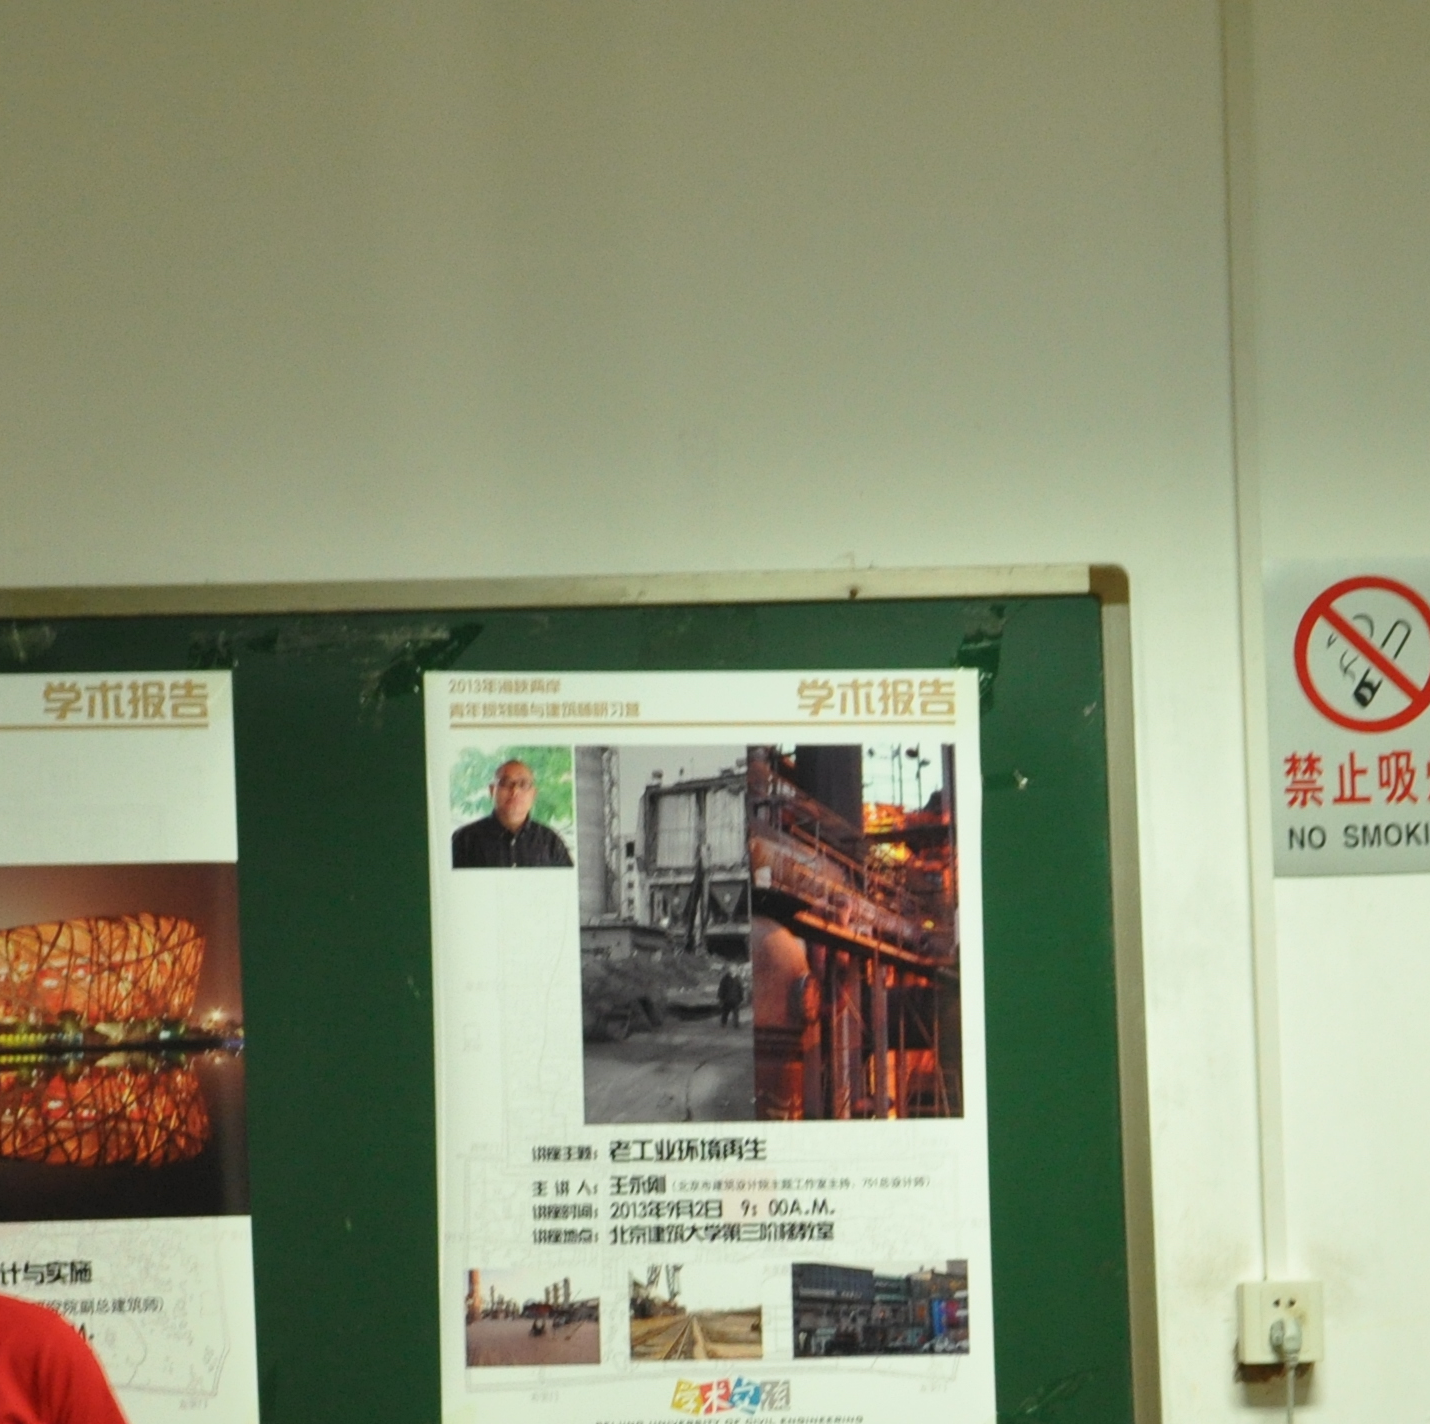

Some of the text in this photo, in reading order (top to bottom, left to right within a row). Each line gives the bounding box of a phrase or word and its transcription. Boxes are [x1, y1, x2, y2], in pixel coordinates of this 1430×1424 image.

[42, 679, 211, 721] 学术报告
[796, 677, 958, 717] 学术报告
[1288, 826, 1327, 851] NO
[610, 1137, 768, 1163] 老工业环境再生
[610, 1174, 667, 1196] 王永刚
[609, 1199, 723, 1221] 2013年9月2日
